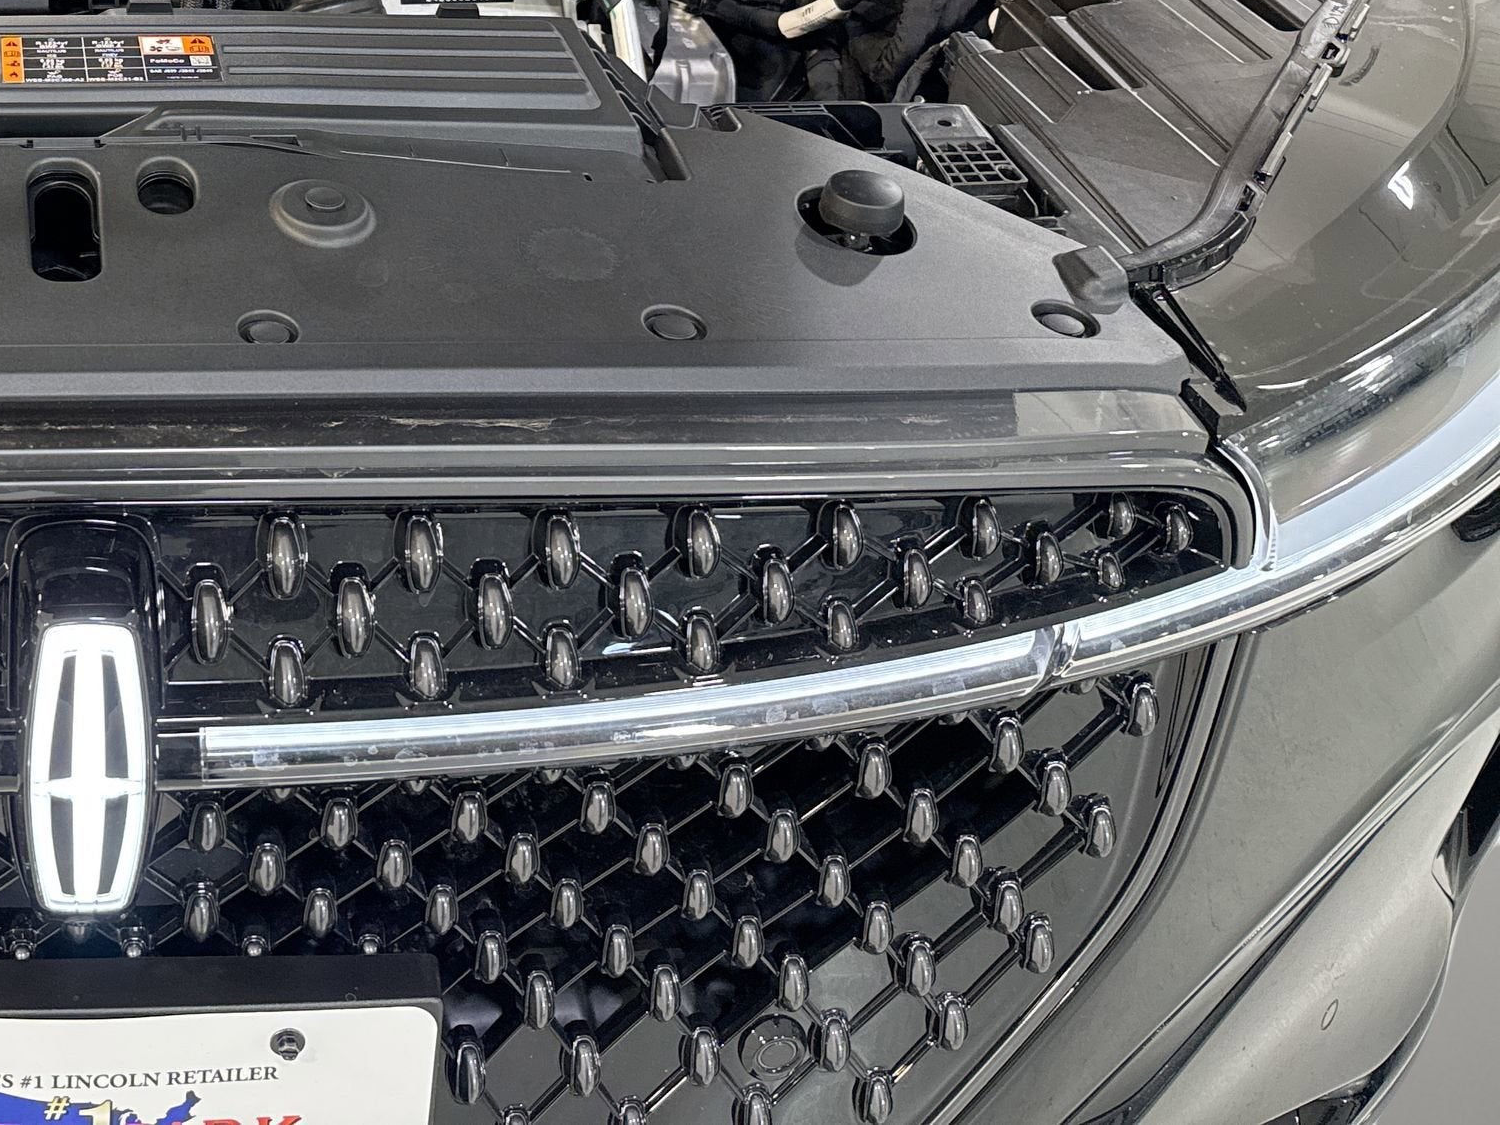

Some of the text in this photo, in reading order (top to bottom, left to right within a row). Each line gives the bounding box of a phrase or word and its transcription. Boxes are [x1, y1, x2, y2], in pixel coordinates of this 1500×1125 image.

[20, 1074, 44, 1089] #1
[51, 1072, 161, 1089] LINCOLN
[166, 1066, 279, 1086] RETAILER
